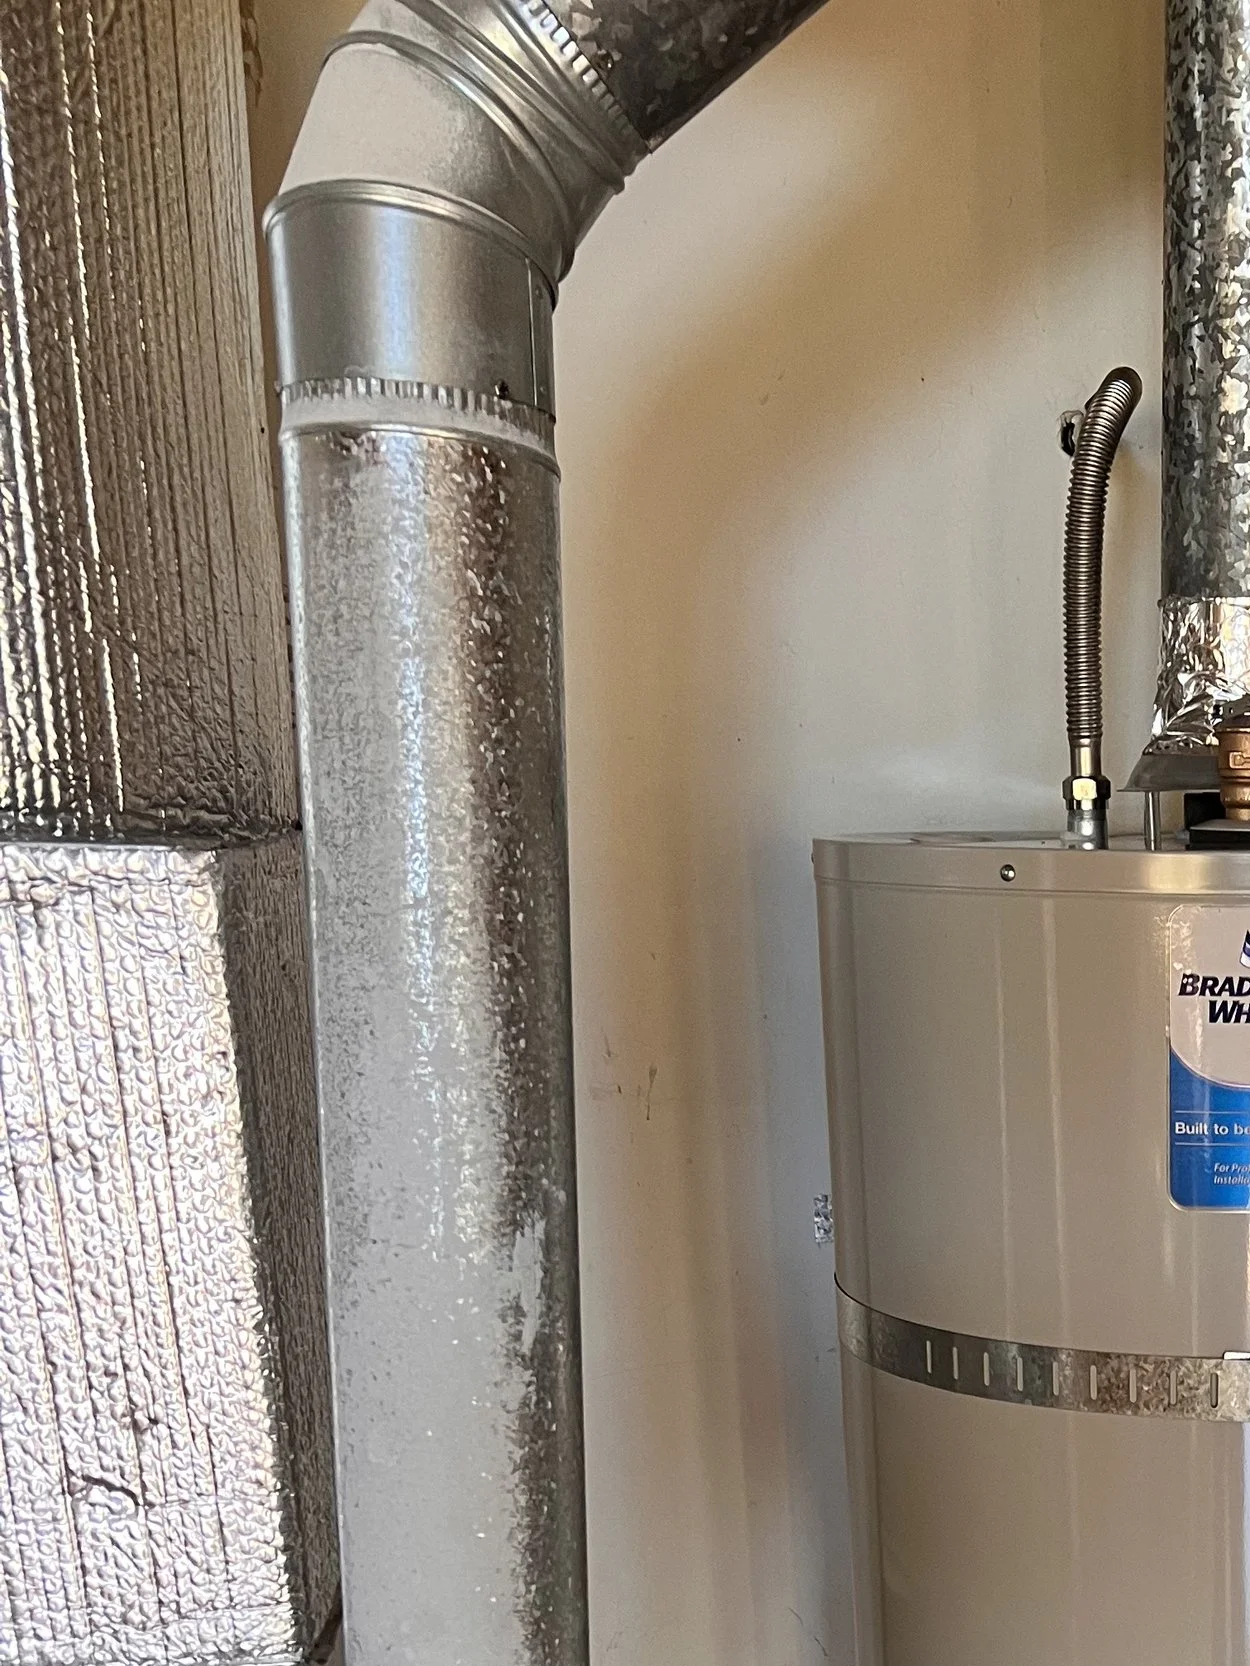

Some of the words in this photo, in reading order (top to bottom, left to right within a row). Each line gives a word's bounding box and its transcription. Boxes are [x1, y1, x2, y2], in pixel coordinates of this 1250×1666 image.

[1175, 1122, 1208, 1135] Built
[1214, 1123, 1228, 1135] to
[1214, 1163, 1229, 1172] For
